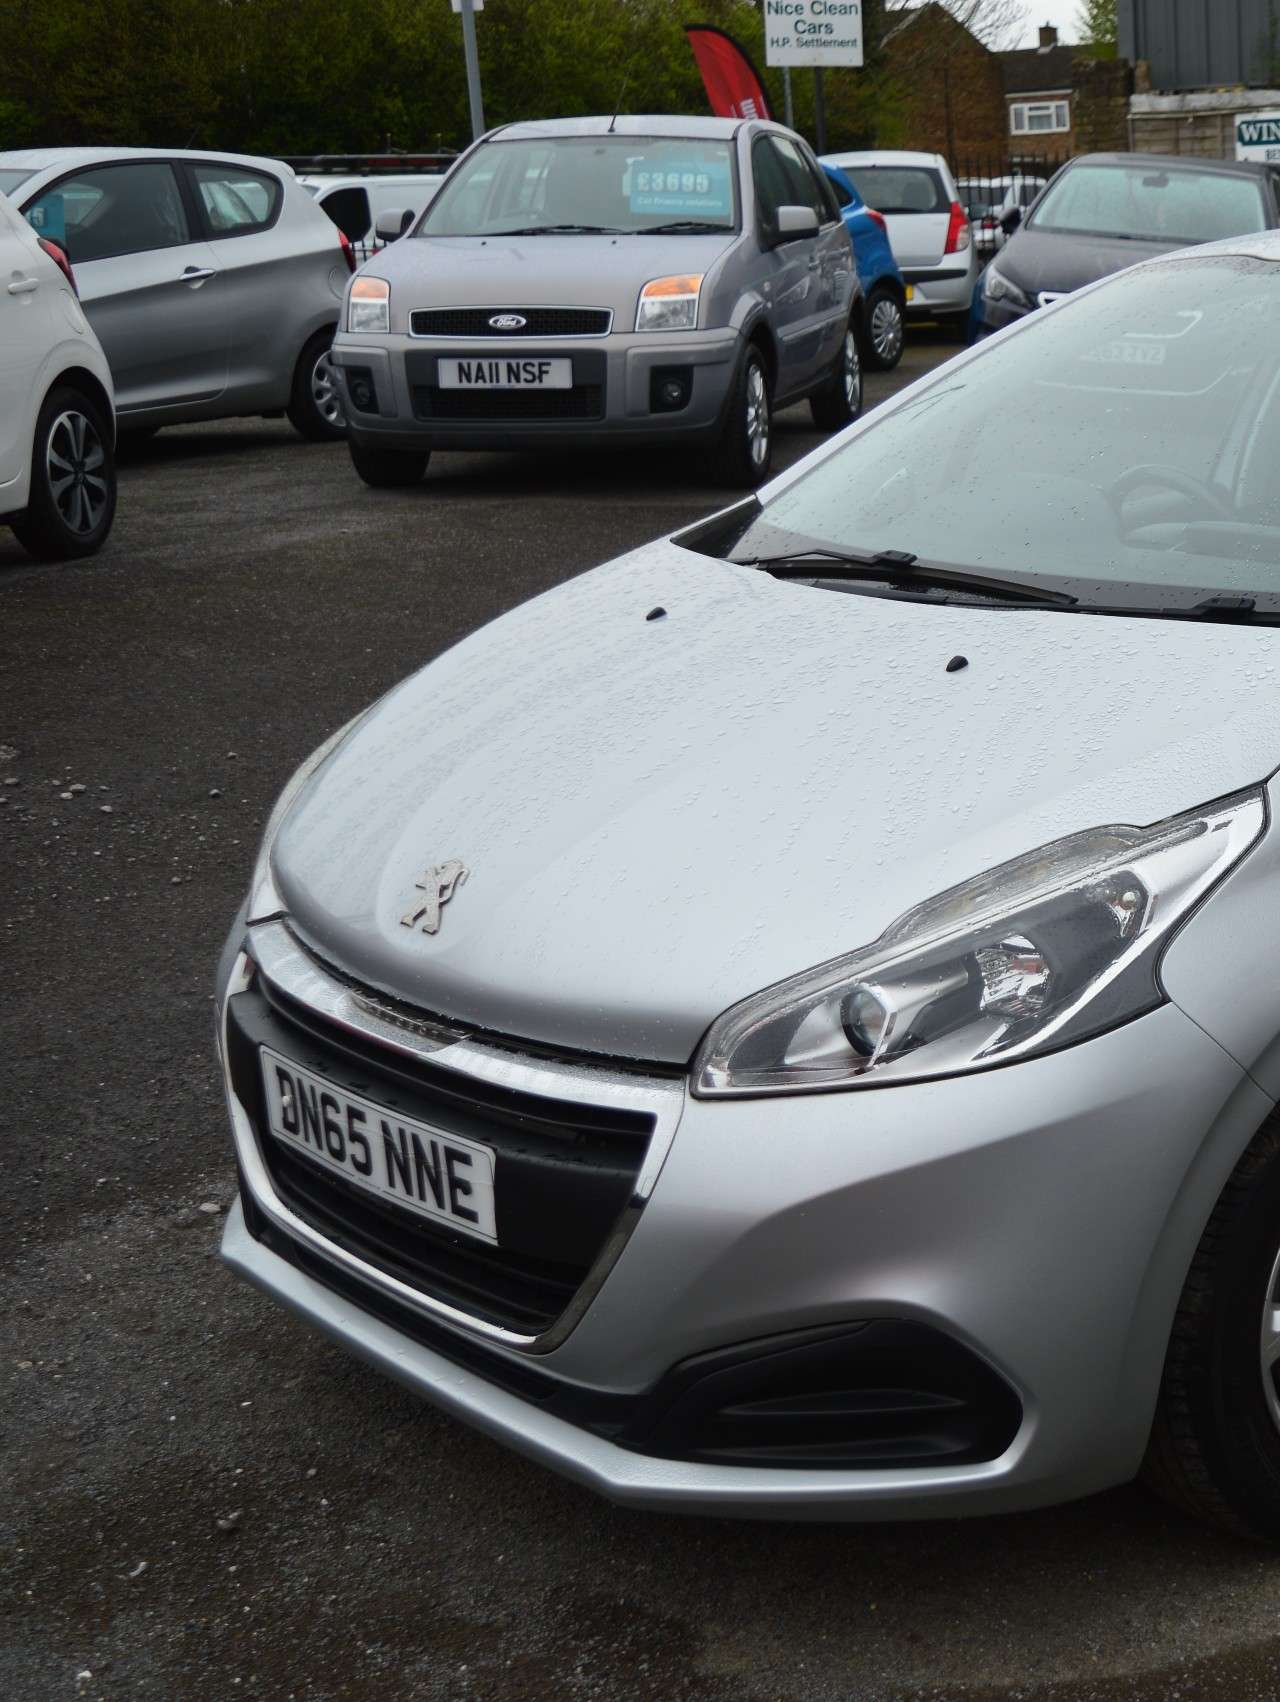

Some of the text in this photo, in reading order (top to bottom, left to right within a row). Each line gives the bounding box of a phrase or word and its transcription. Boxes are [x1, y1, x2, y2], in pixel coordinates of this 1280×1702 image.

[767, 0, 859, 15] Nice Clean
[794, 19, 834, 34] Cars
[796, 37, 857, 48] Settlement
[506, 361, 552, 384] NSF
[275, 1064, 479, 1225] DN65 NNE
